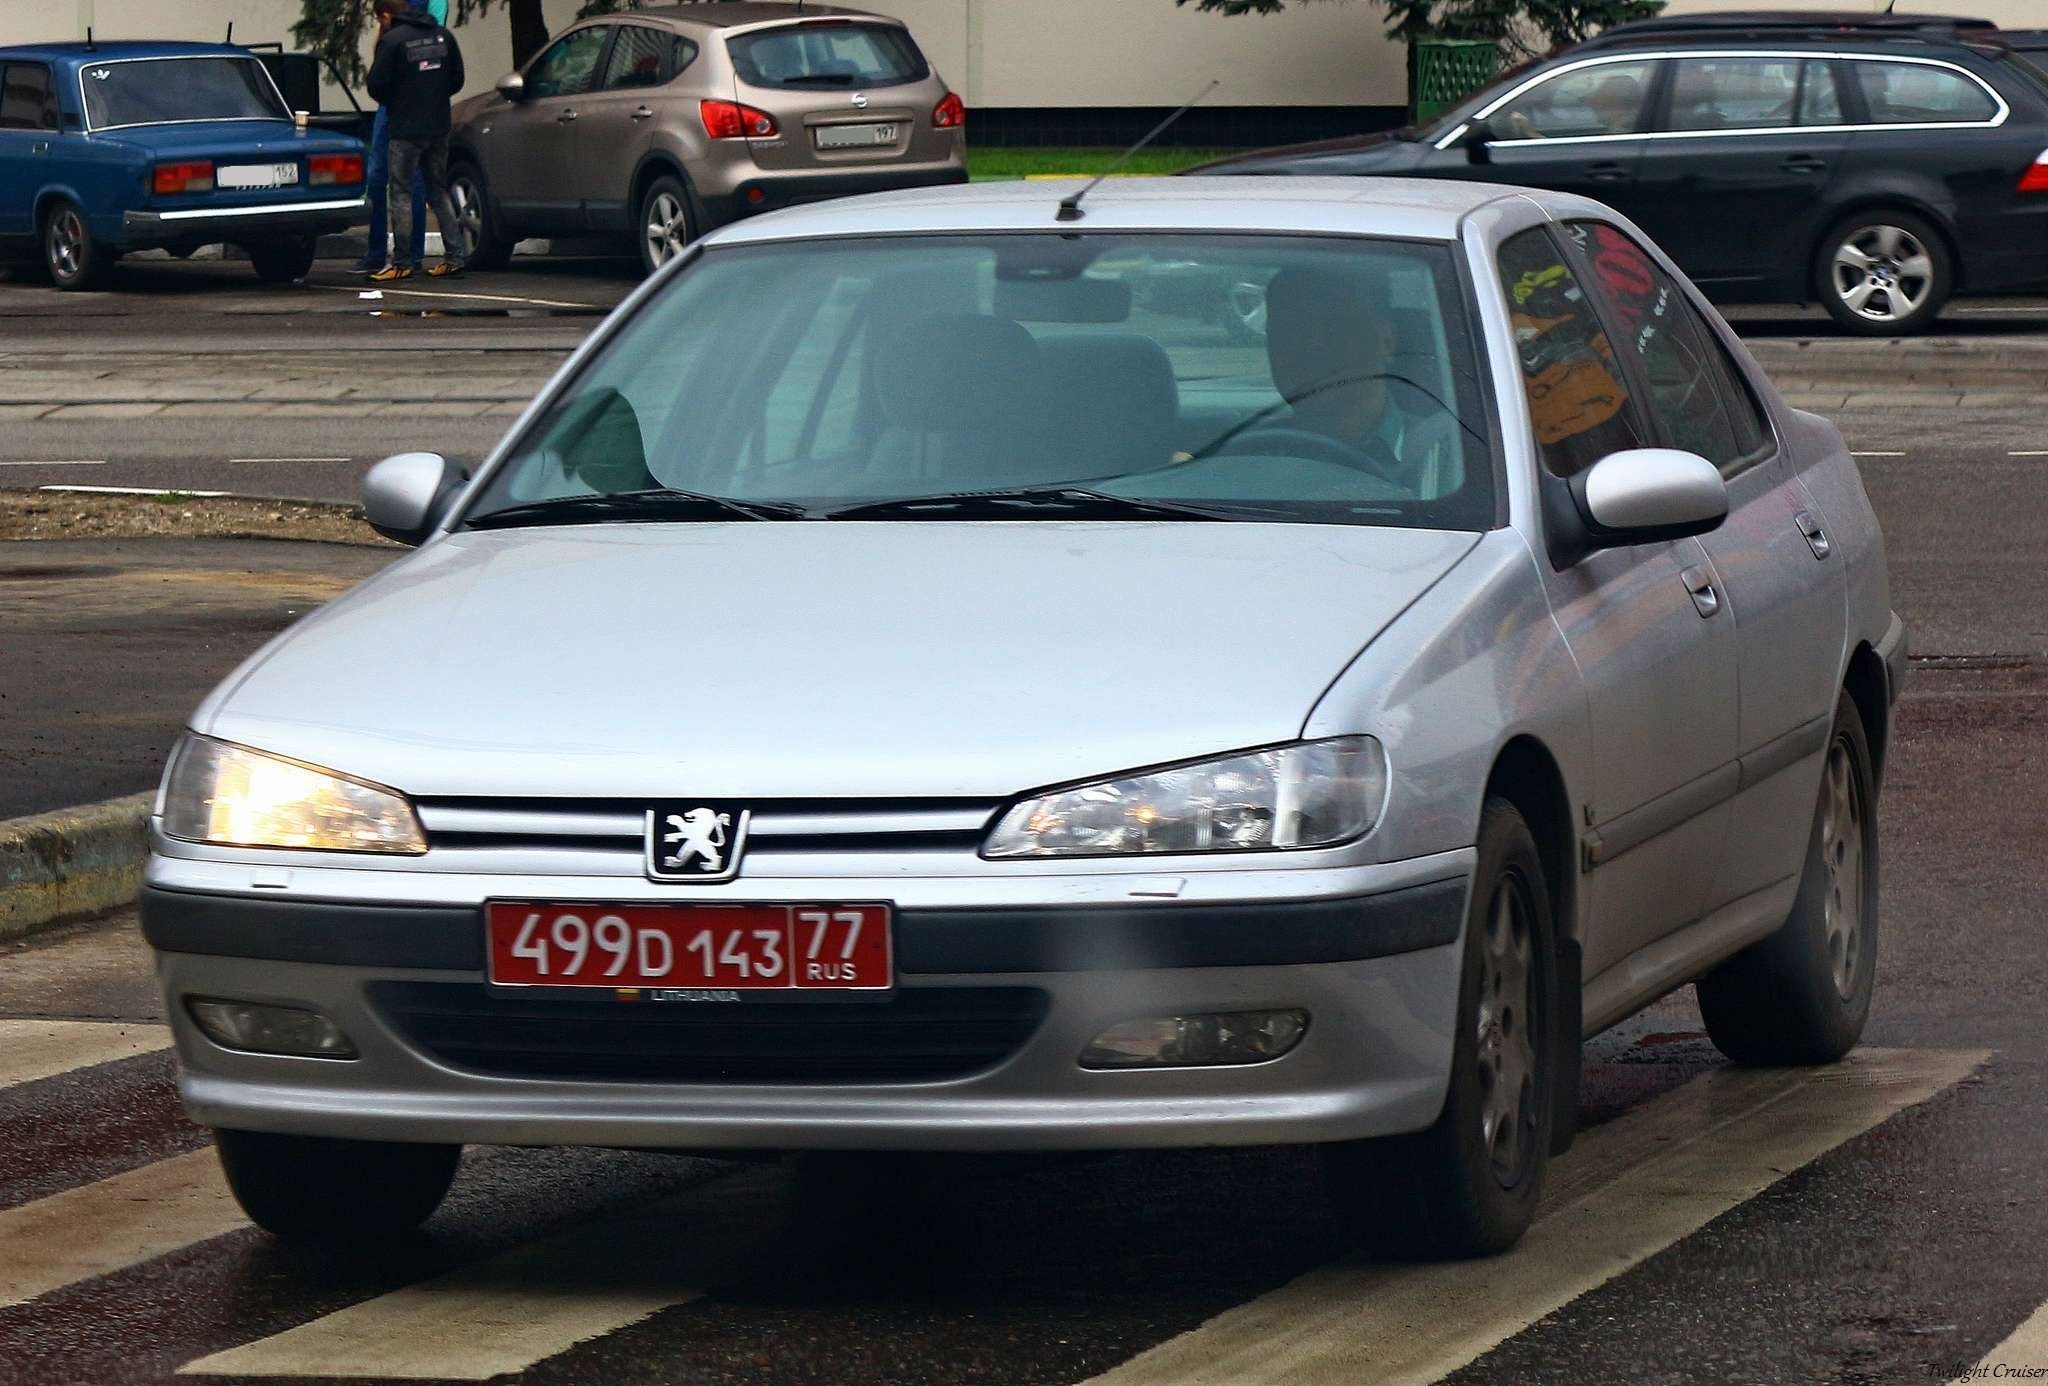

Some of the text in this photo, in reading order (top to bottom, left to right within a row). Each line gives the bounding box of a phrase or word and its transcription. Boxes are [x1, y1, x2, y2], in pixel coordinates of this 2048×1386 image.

[686, 929, 784, 978] 143
[799, 912, 864, 960] 77
[806, 962, 858, 981] RUS
[650, 989, 742, 1002] LITHUANIA
